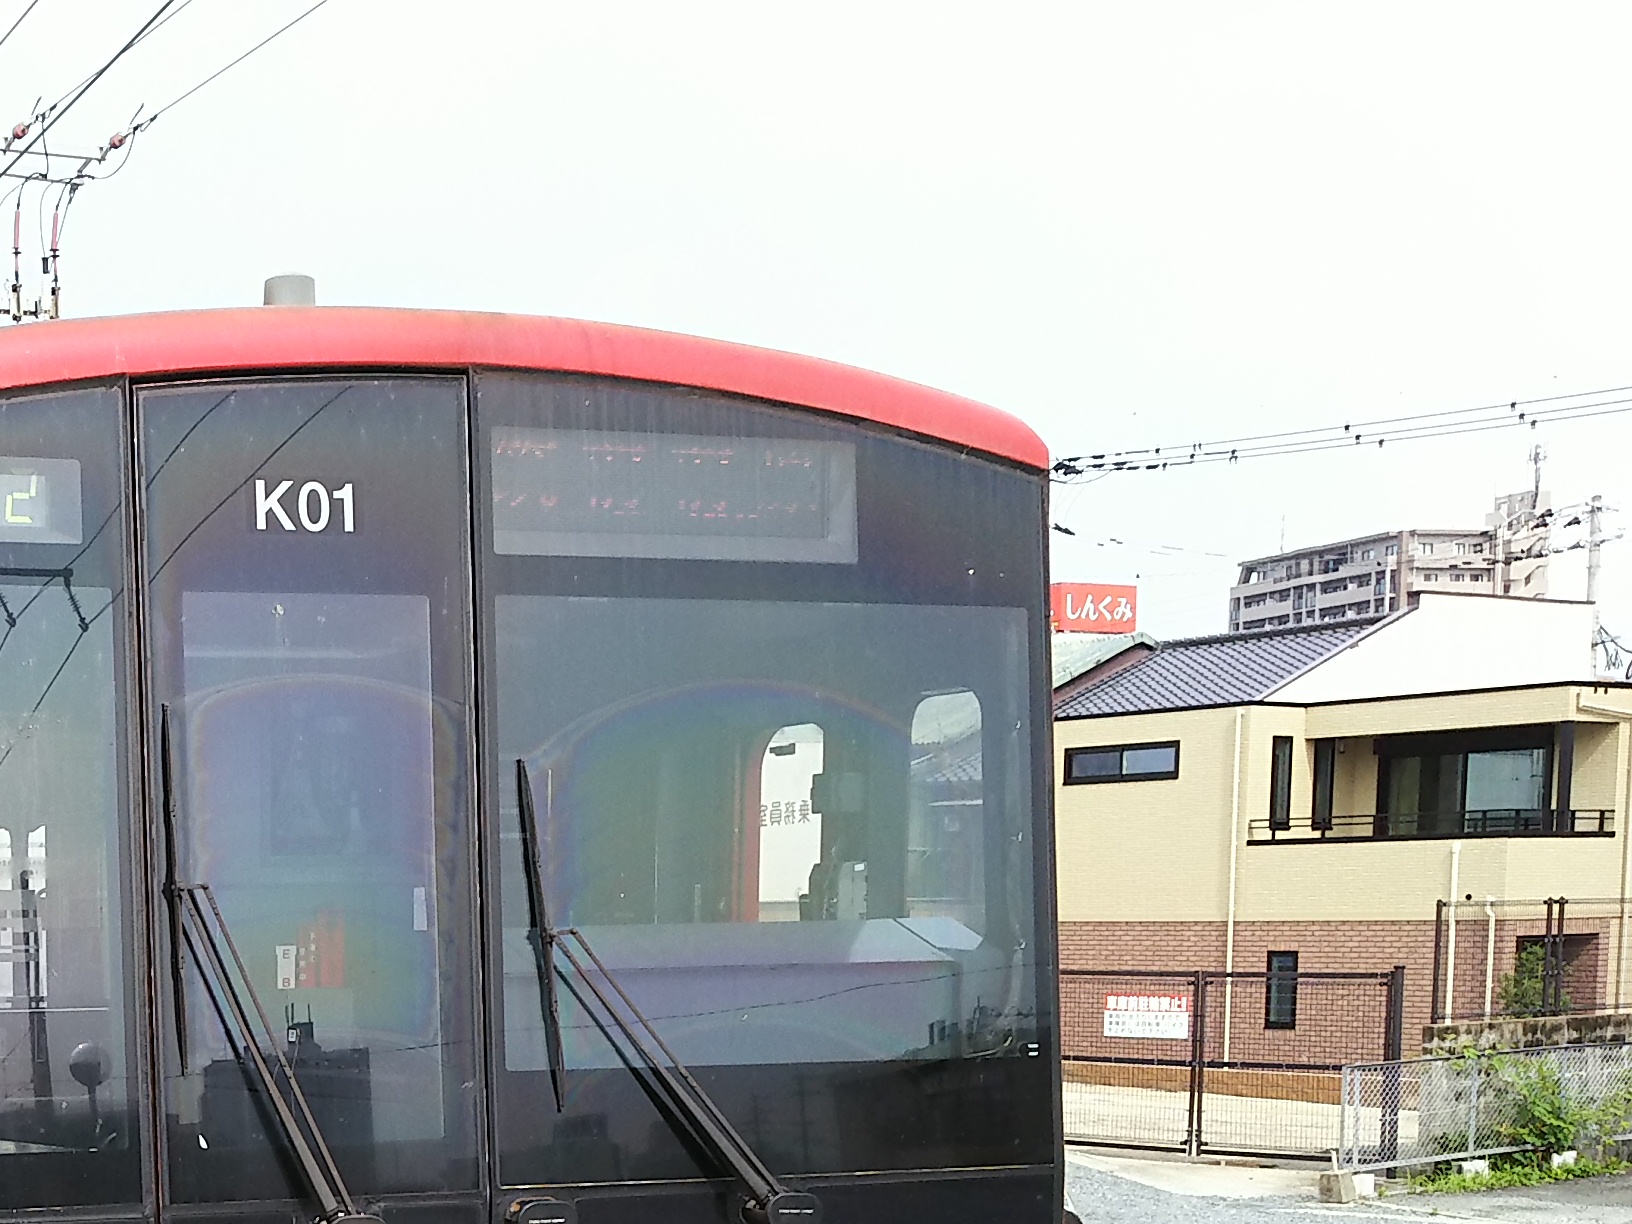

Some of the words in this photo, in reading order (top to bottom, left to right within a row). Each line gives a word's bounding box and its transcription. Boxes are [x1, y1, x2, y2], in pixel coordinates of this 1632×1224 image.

[254, 480, 357, 533] K01
[1066, 593, 1133, 622] しんくみ
